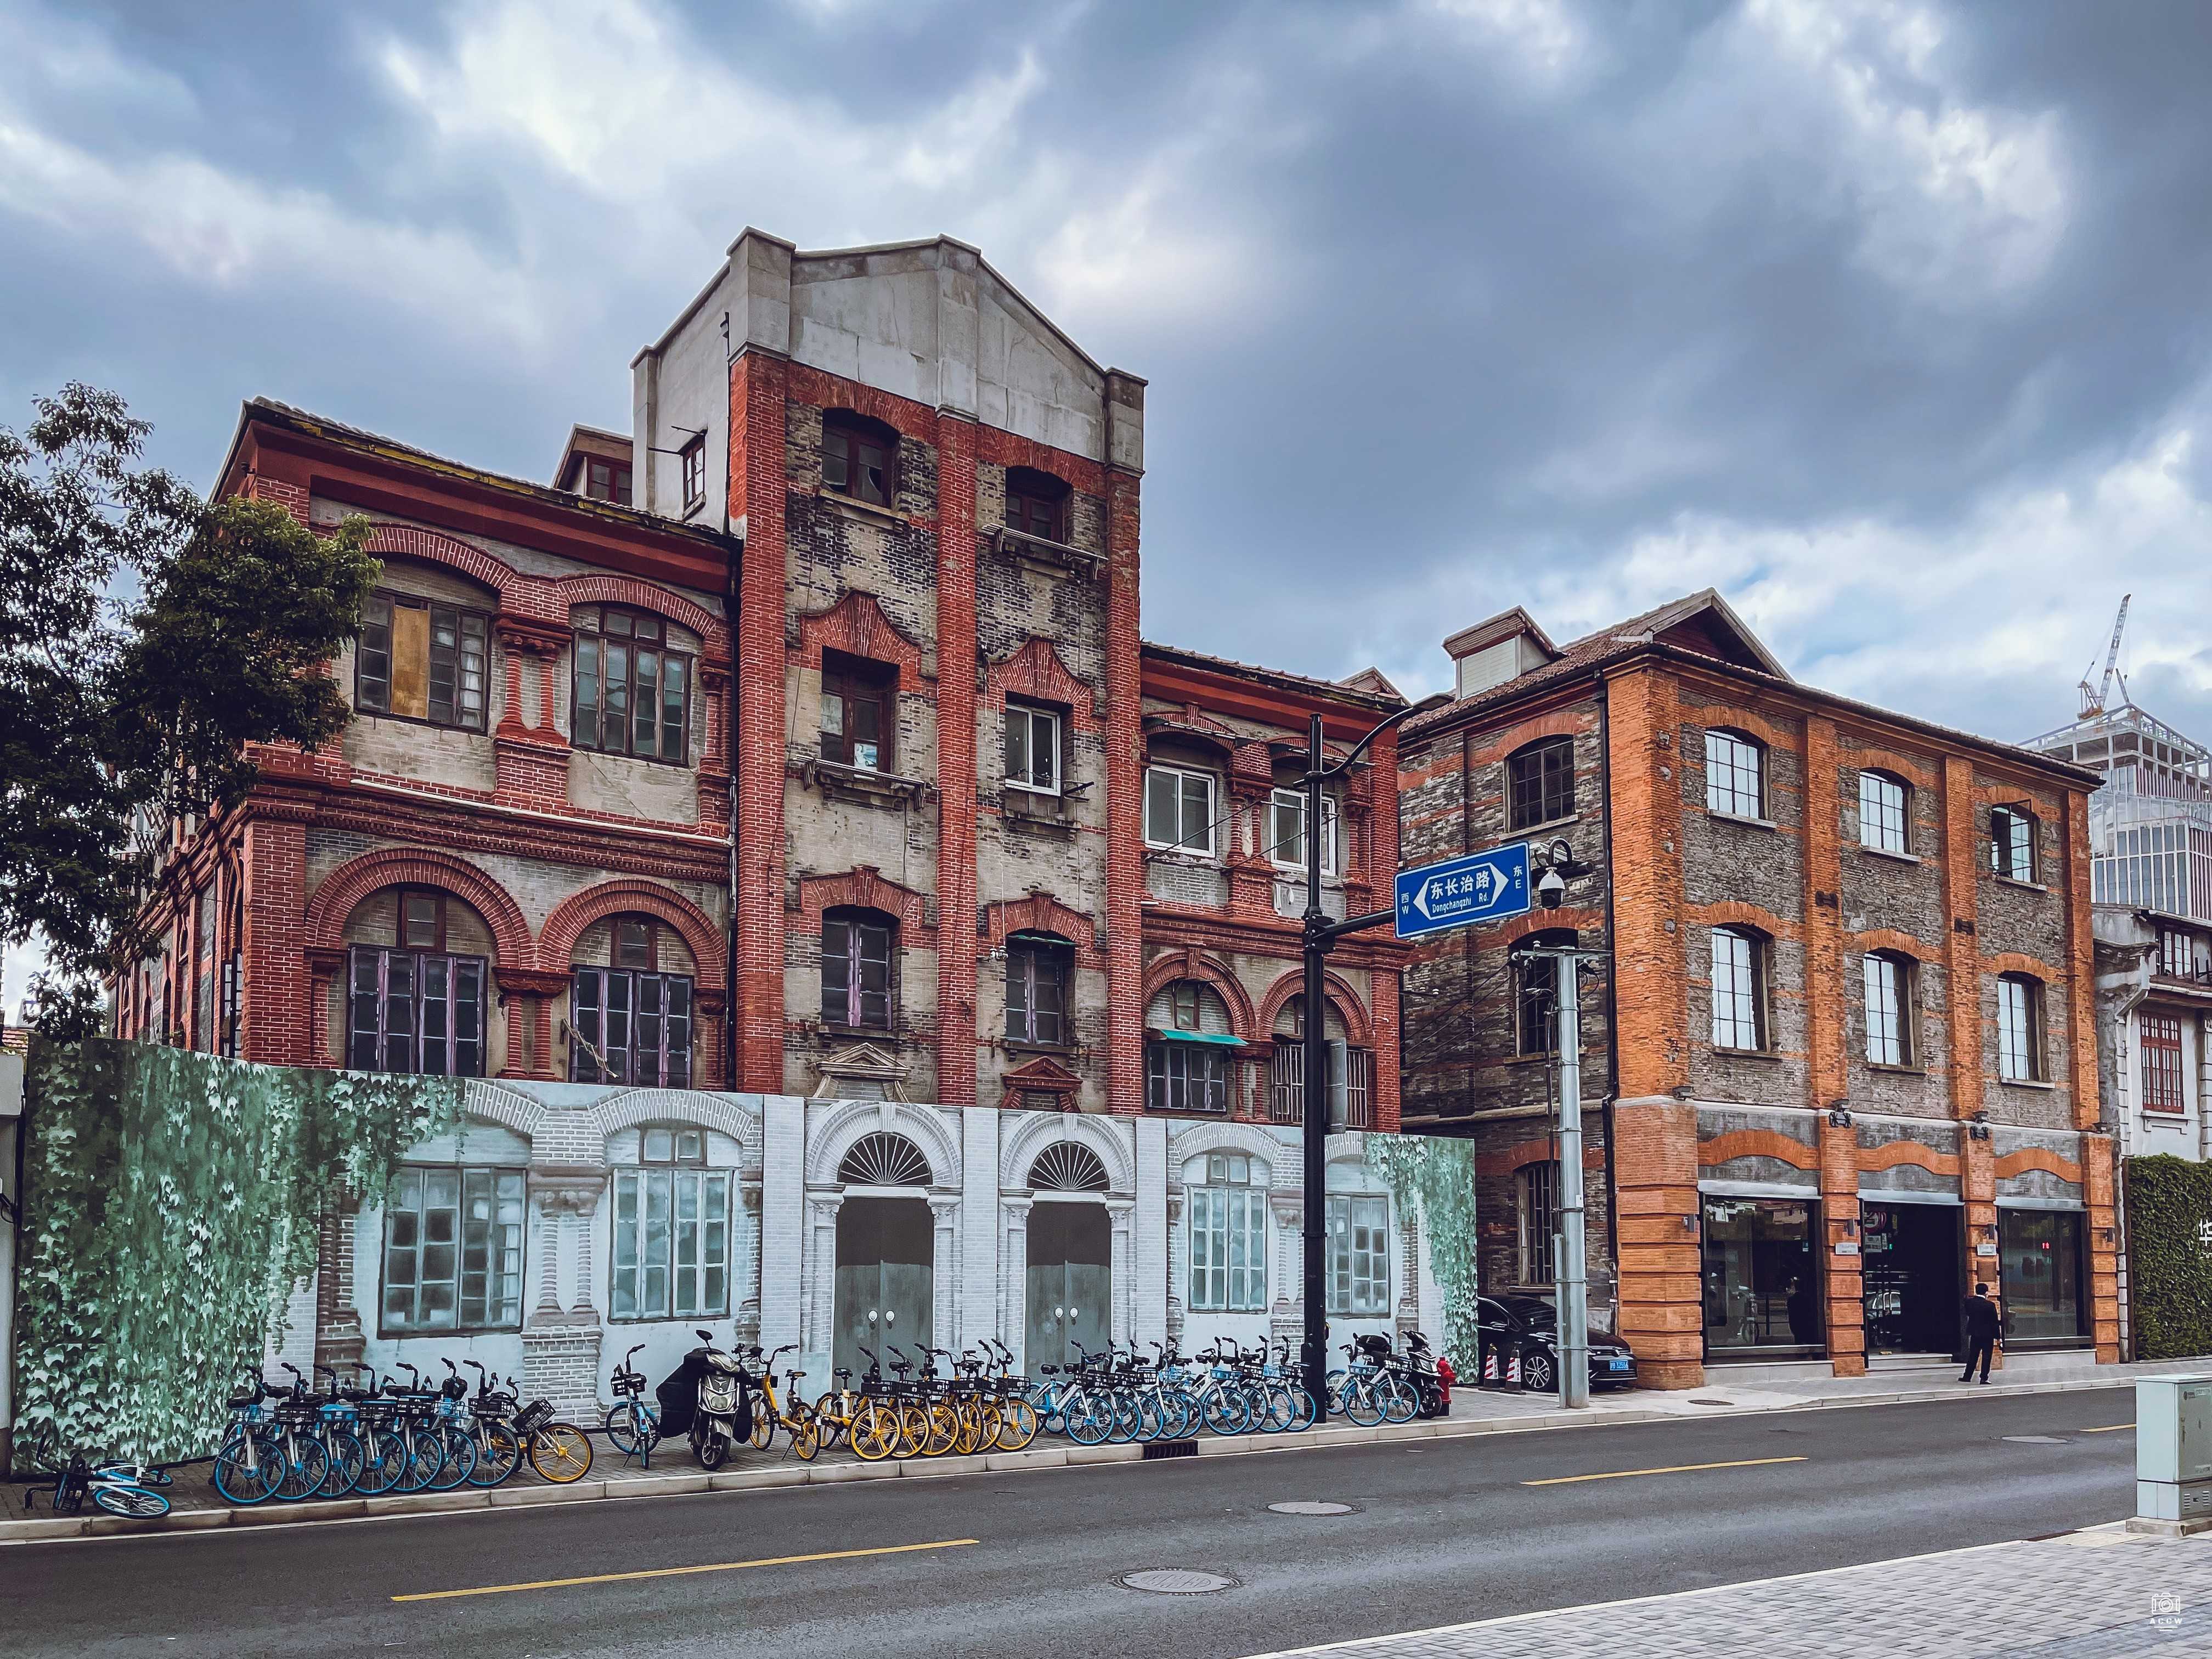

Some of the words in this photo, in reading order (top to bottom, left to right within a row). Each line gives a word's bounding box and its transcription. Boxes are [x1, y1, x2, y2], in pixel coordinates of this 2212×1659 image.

[1513, 865, 1522, 877] 东
[1430, 870, 1490, 900] 东长治路
[1515, 879, 1522, 889] E
[1401, 892, 1409, 904] 西
[1432, 896, 1471, 913] Dongchangzhi
[1479, 891, 1489, 903] Rd.
[1402, 905, 1409, 915] W
